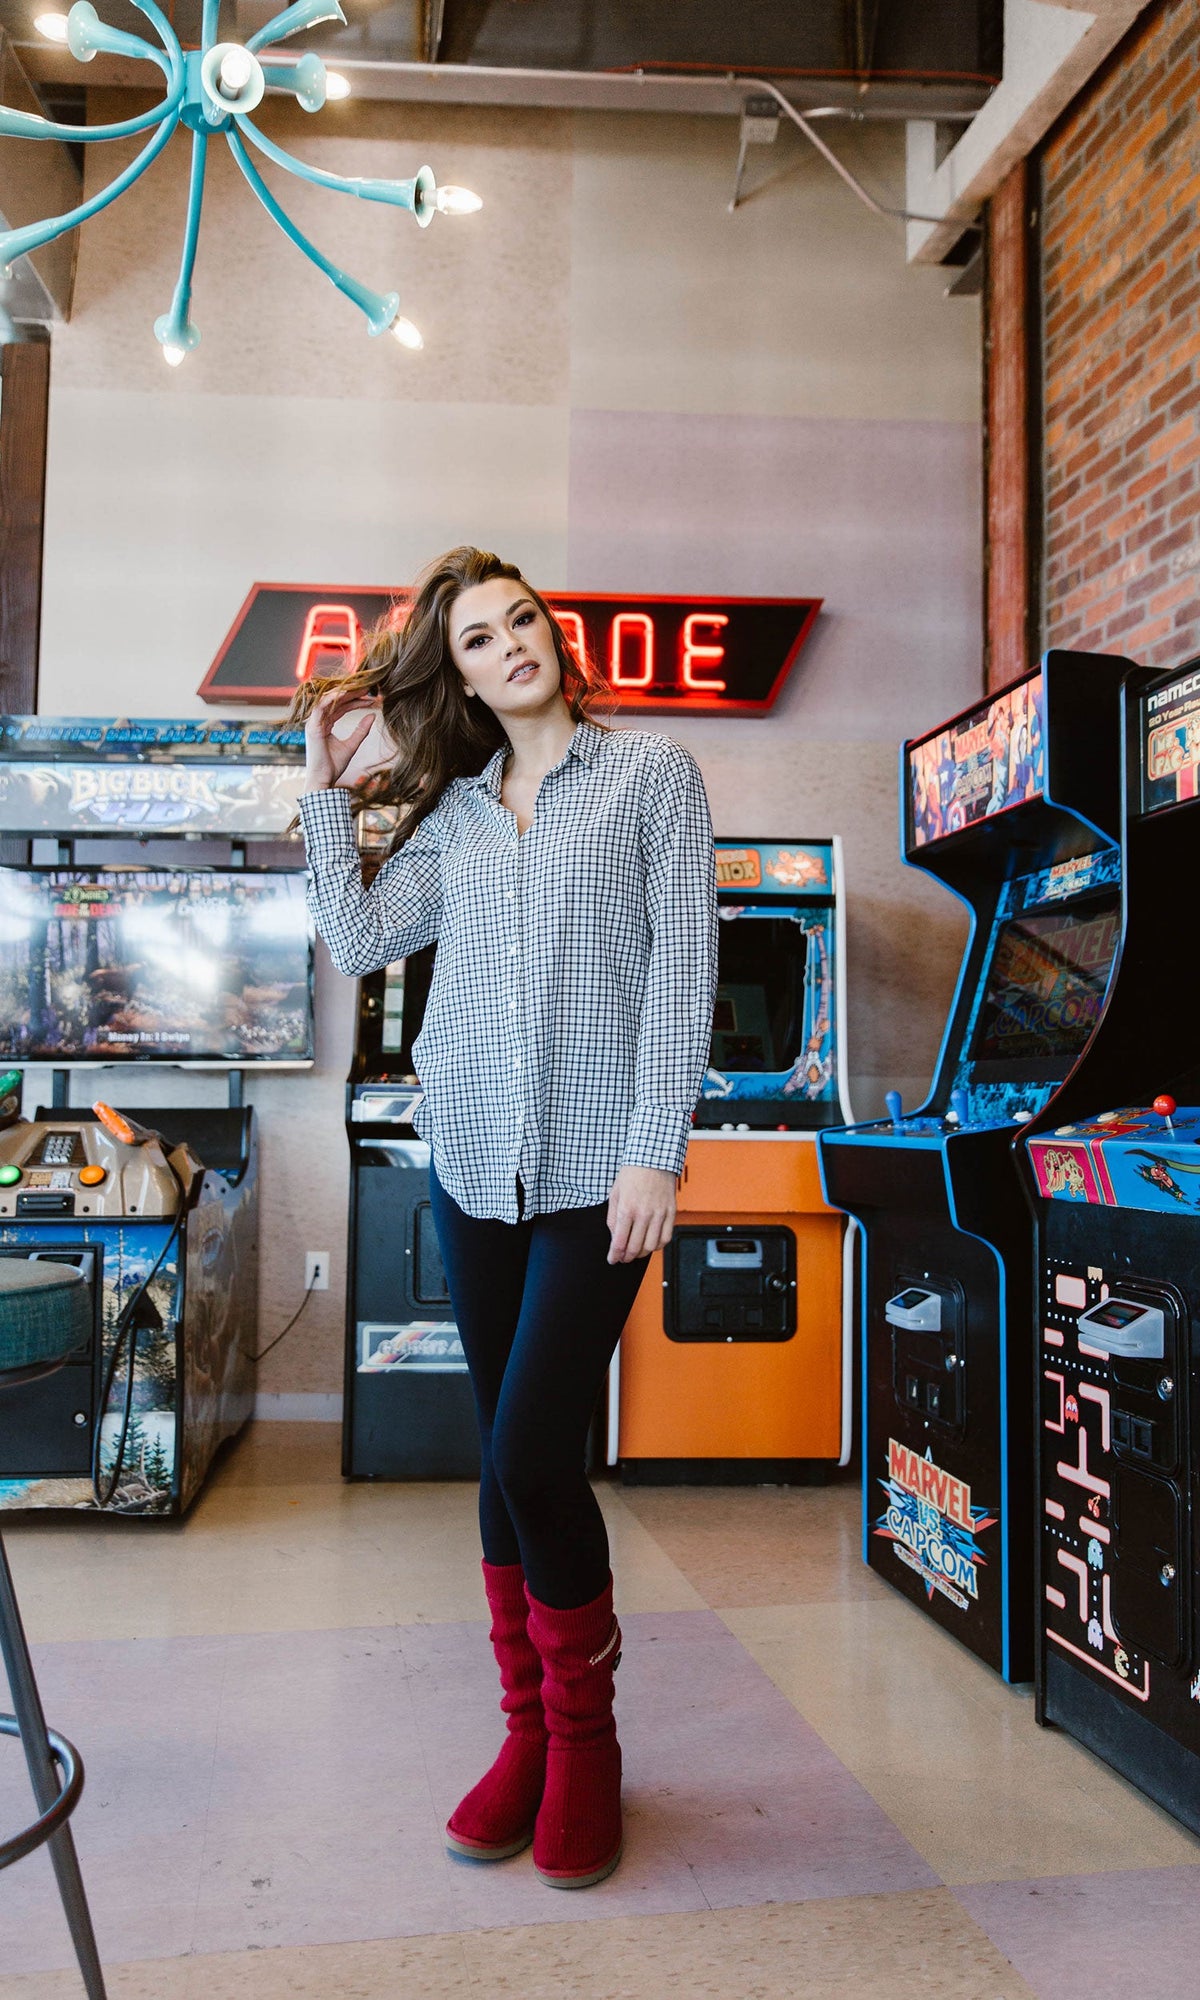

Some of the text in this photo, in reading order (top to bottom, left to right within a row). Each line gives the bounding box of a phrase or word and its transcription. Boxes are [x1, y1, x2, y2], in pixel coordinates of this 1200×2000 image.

[105, 728, 157, 743] GAME
[71, 769, 126, 802] BIG
[131, 769, 217, 808] BUCK
[889, 1438, 976, 1534] MARVEL
[917, 1498, 943, 1541] VS.
[887, 1506, 979, 1600] CAPCOM
